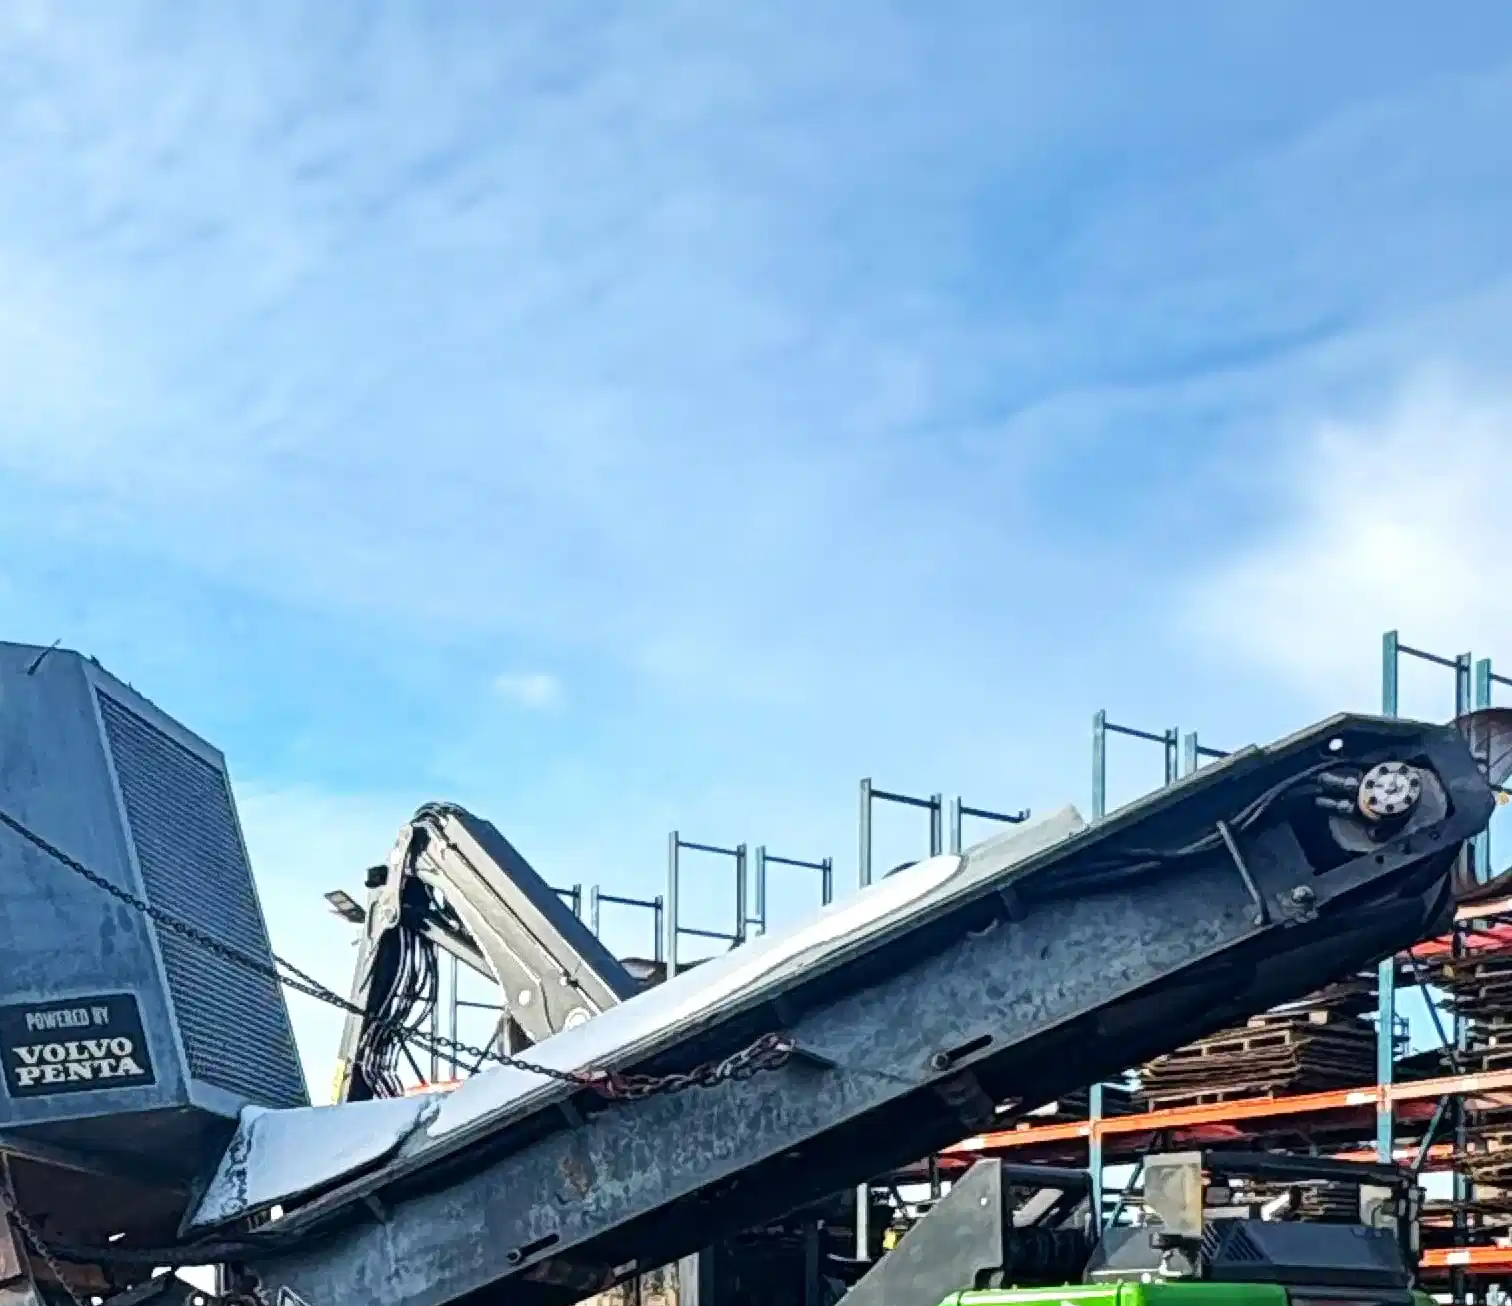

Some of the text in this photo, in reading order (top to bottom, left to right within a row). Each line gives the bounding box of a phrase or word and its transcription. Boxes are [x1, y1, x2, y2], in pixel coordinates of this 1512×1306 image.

[25, 1008, 90, 1032] POWERED
[11, 1036, 134, 1064] VOLVO
[14, 1056, 145, 1086] PENTA
